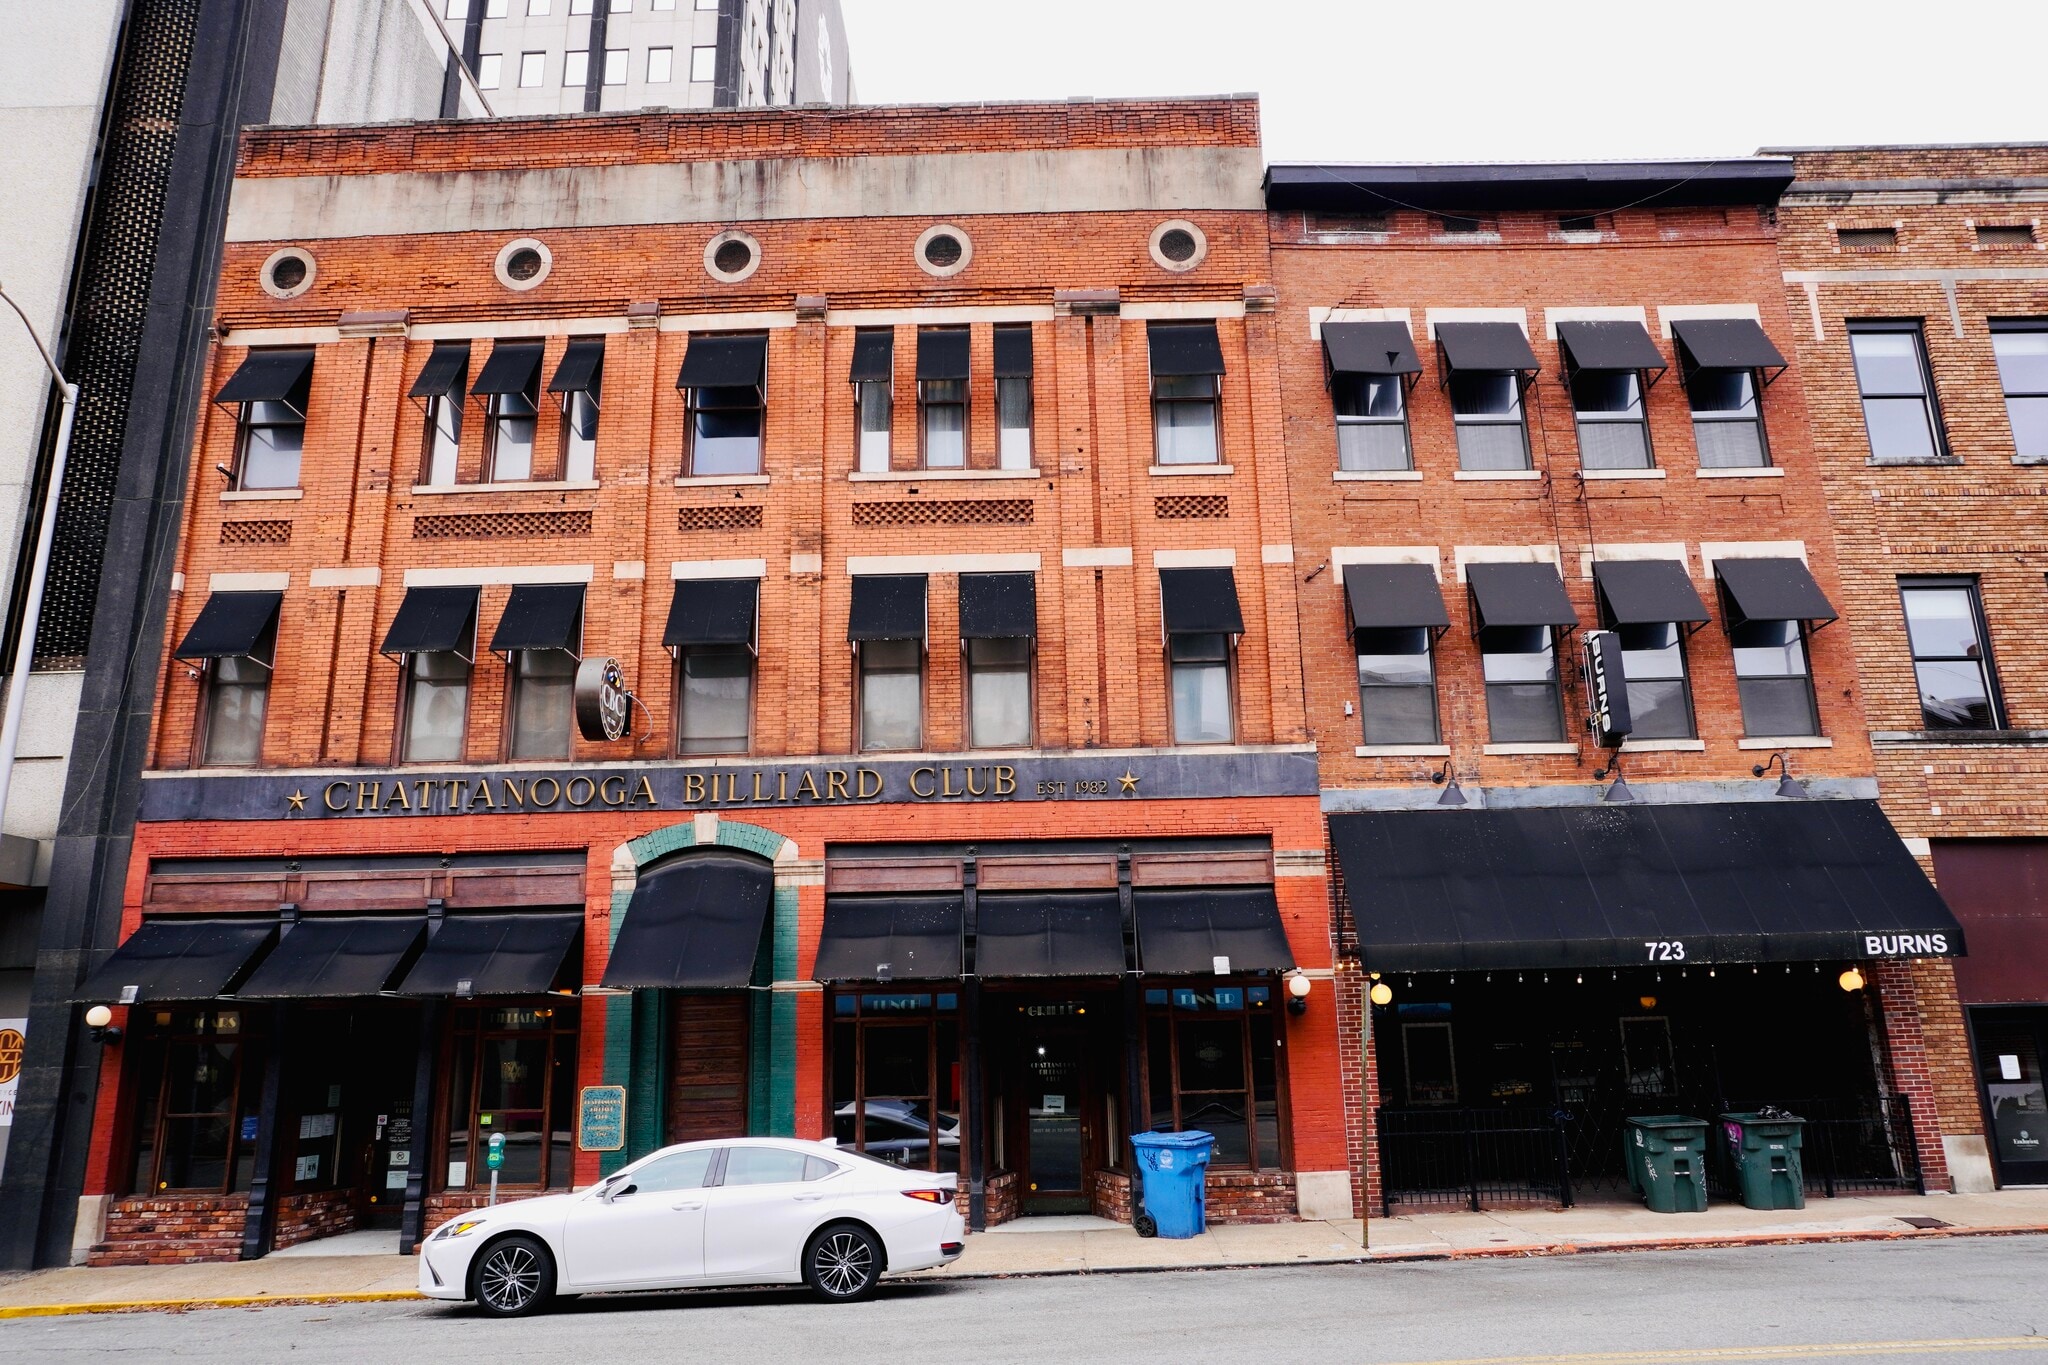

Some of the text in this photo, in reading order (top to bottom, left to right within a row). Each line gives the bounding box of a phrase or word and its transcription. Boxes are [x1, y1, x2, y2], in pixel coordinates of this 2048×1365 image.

[1591, 637, 1612, 732] BURNS
[603, 684, 624, 717] CBC
[323, 764, 1109, 812] CHATTANOOGA BILLIARD CLUB EST 1982
[1645, 941, 1685, 961] 723
[1865, 934, 1948, 955] BURNS
[873, 999, 921, 1010] LUNCH
[1181, 993, 1235, 1005] DINNER
